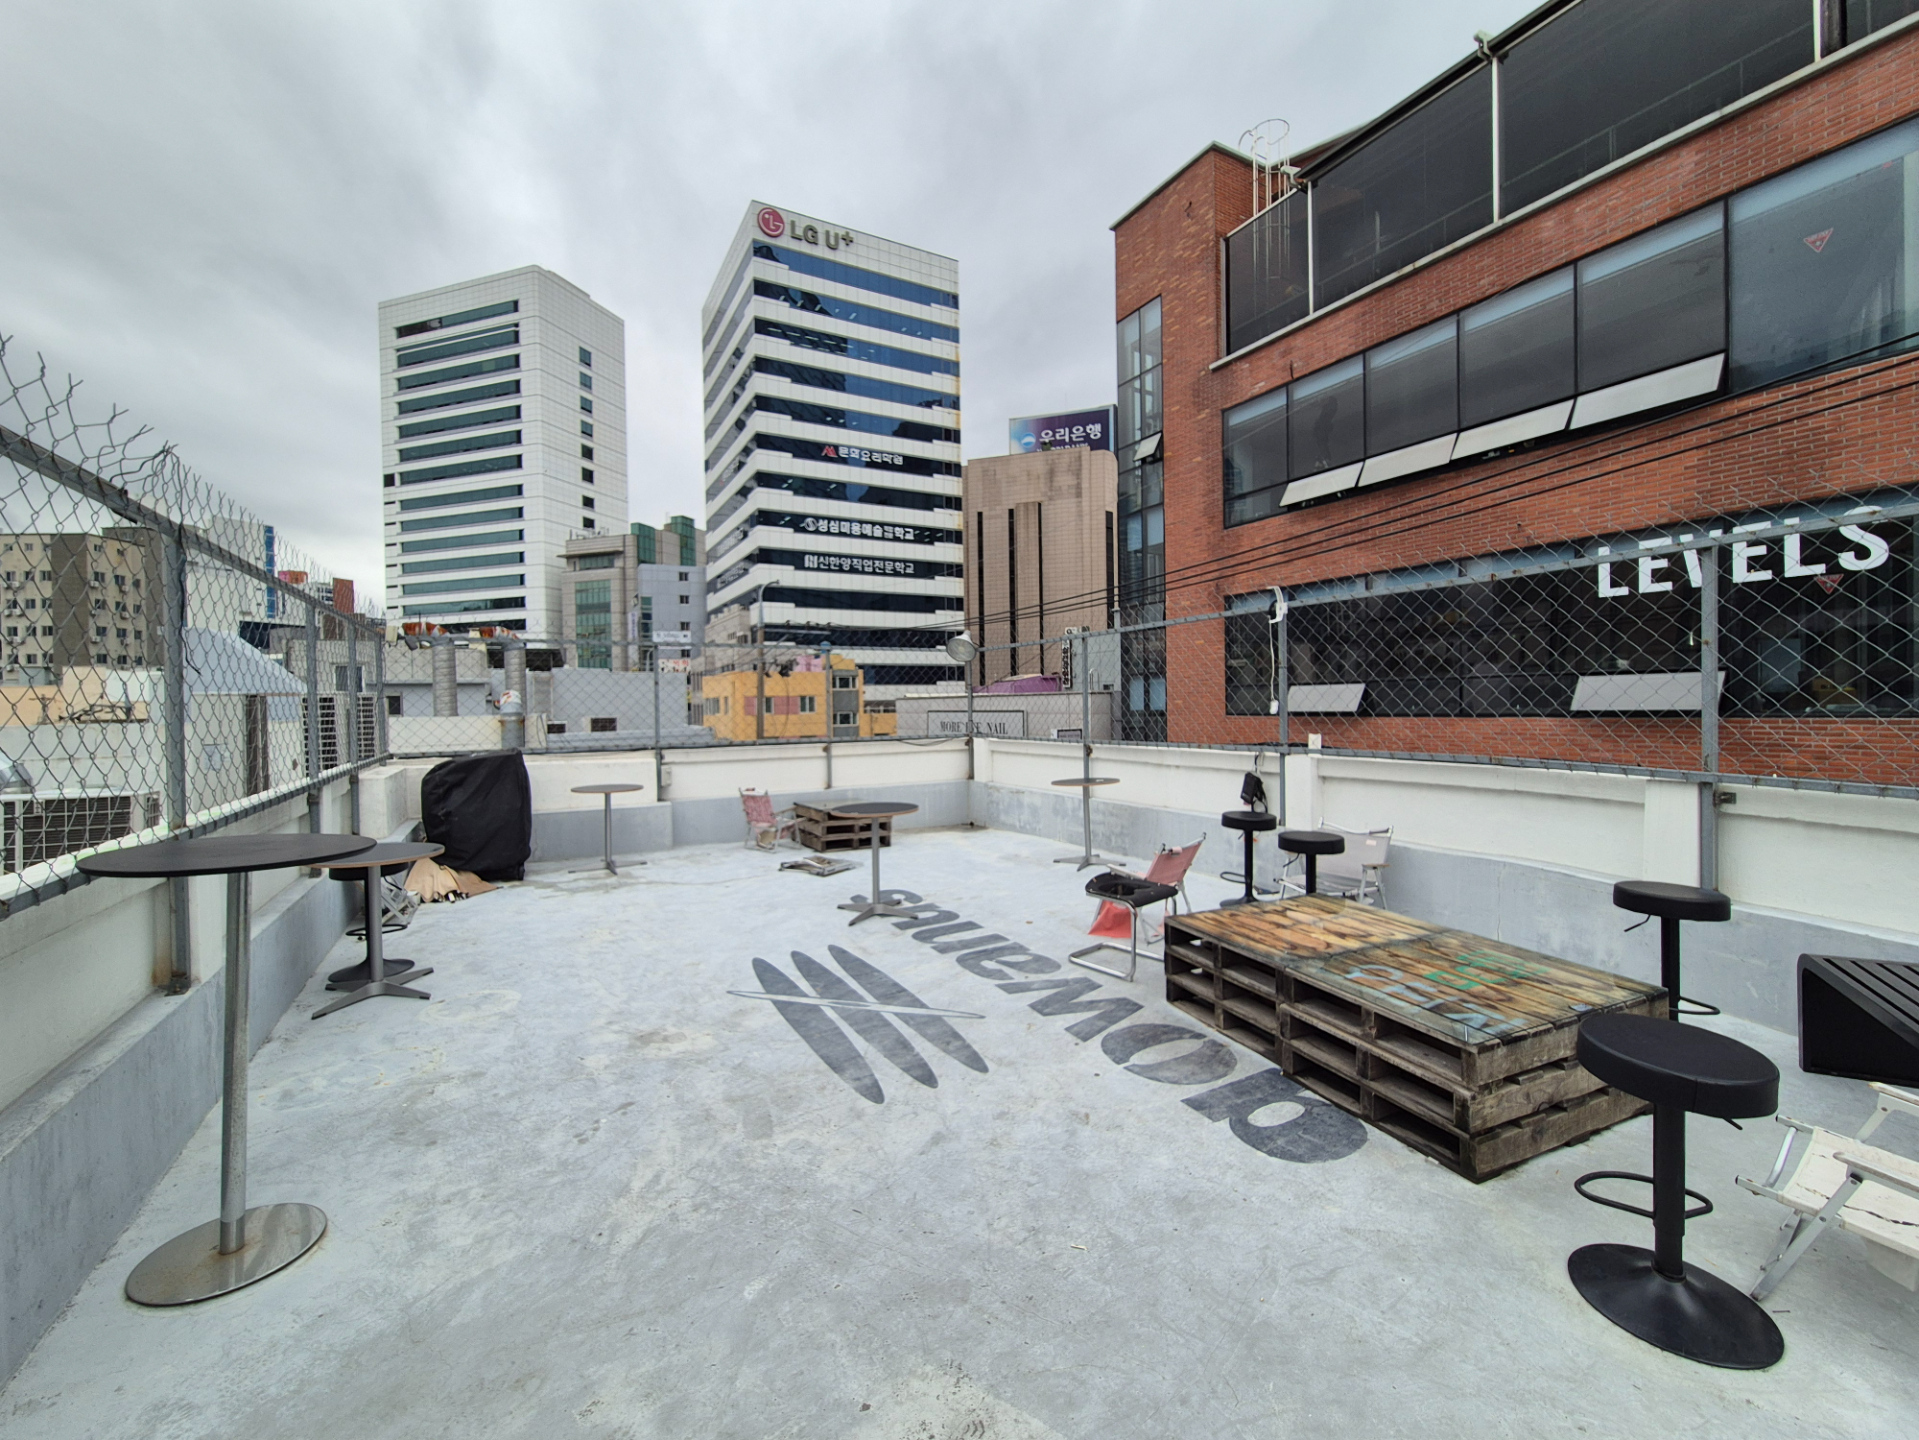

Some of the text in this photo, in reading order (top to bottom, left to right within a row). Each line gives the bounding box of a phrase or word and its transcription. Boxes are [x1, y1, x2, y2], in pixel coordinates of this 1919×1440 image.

[789, 220, 854, 250] LG U+
[1039, 423, 1102, 443] 우리은행
[1597, 505, 1890, 598] LEVELS
[818, 554, 915, 574] 신한양직업전문학교
[987, 722, 1008, 735] NAIL
